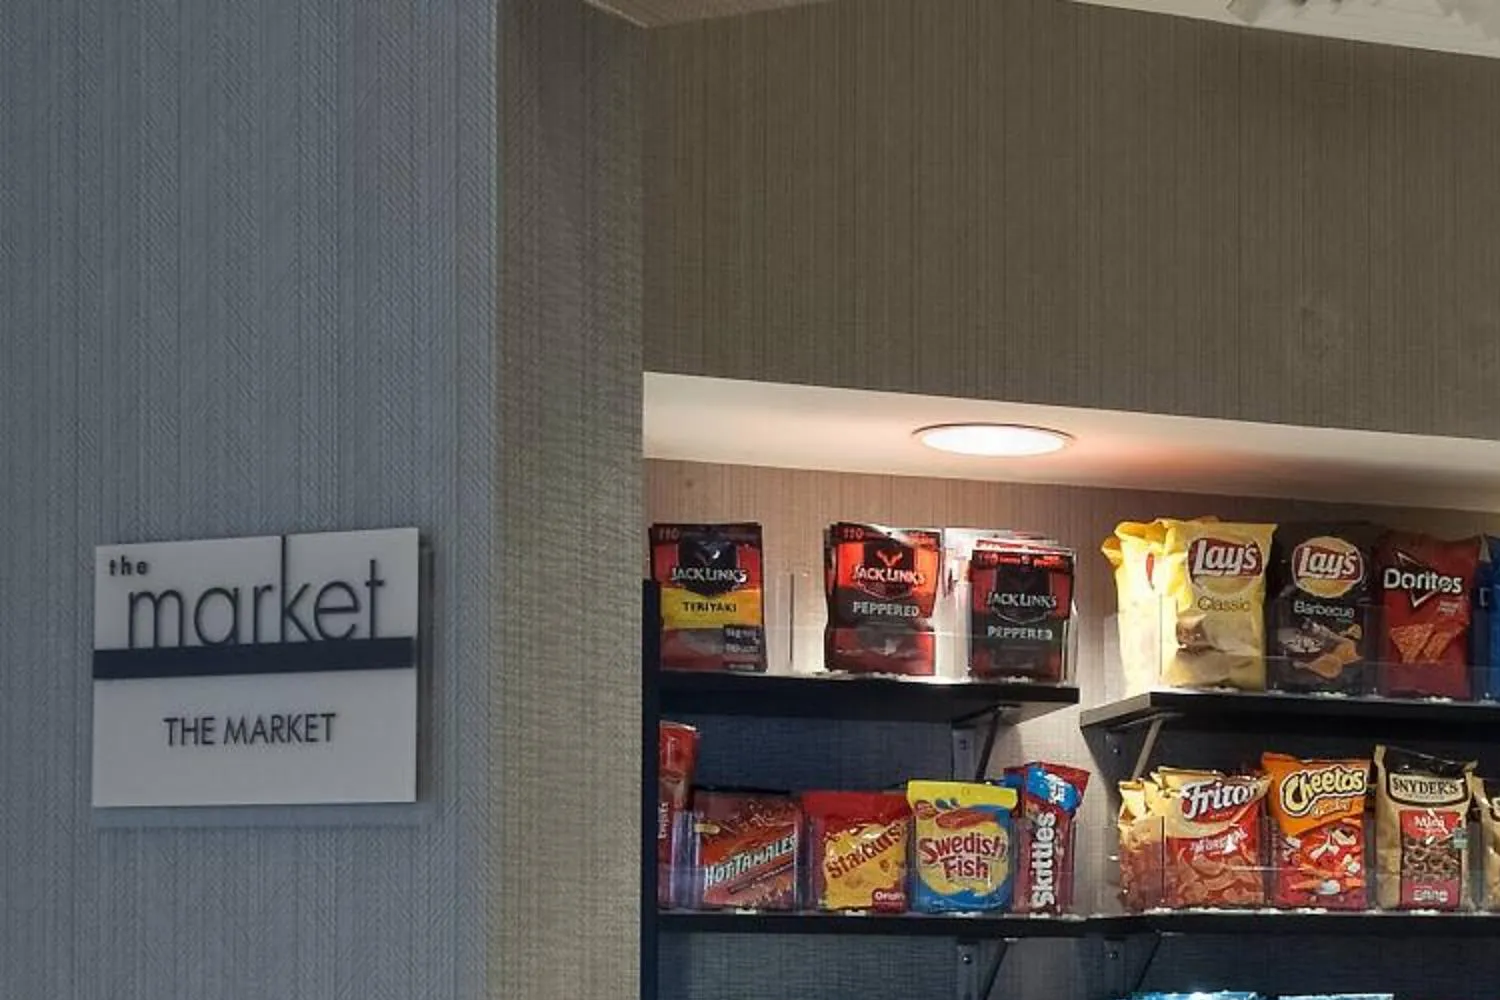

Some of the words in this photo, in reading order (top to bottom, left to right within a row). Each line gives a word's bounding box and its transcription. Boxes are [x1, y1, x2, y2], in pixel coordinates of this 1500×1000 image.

[108, 555, 149, 576] the
[1193, 539, 1258, 577] Lay's
[1297, 544, 1358, 579] Lay's
[671, 566, 705, 581] JACK
[1383, 567, 1464, 595] Doritos
[127, 534, 386, 648] market
[987, 592, 1019, 607] JACK
[682, 601, 737, 614] TERIYAKI
[852, 601, 920, 618] PEPPERED
[1197, 595, 1250, 613] Classic
[1293, 600, 1355, 619] Barbecue
[987, 625, 1054, 641] PEPPERED
[163, 716, 216, 746] THE
[224, 713, 337, 745] MARKET
[1282, 767, 1364, 816] Cheetos
[1392, 778, 1459, 796] SNYDER'S
[918, 832, 1007, 865] Swedish
[1031, 811, 1056, 909] Skittles
[704, 860, 735, 890] HOT
[733, 832, 797, 878] TAMALES
[941, 856, 989, 880] Fish
